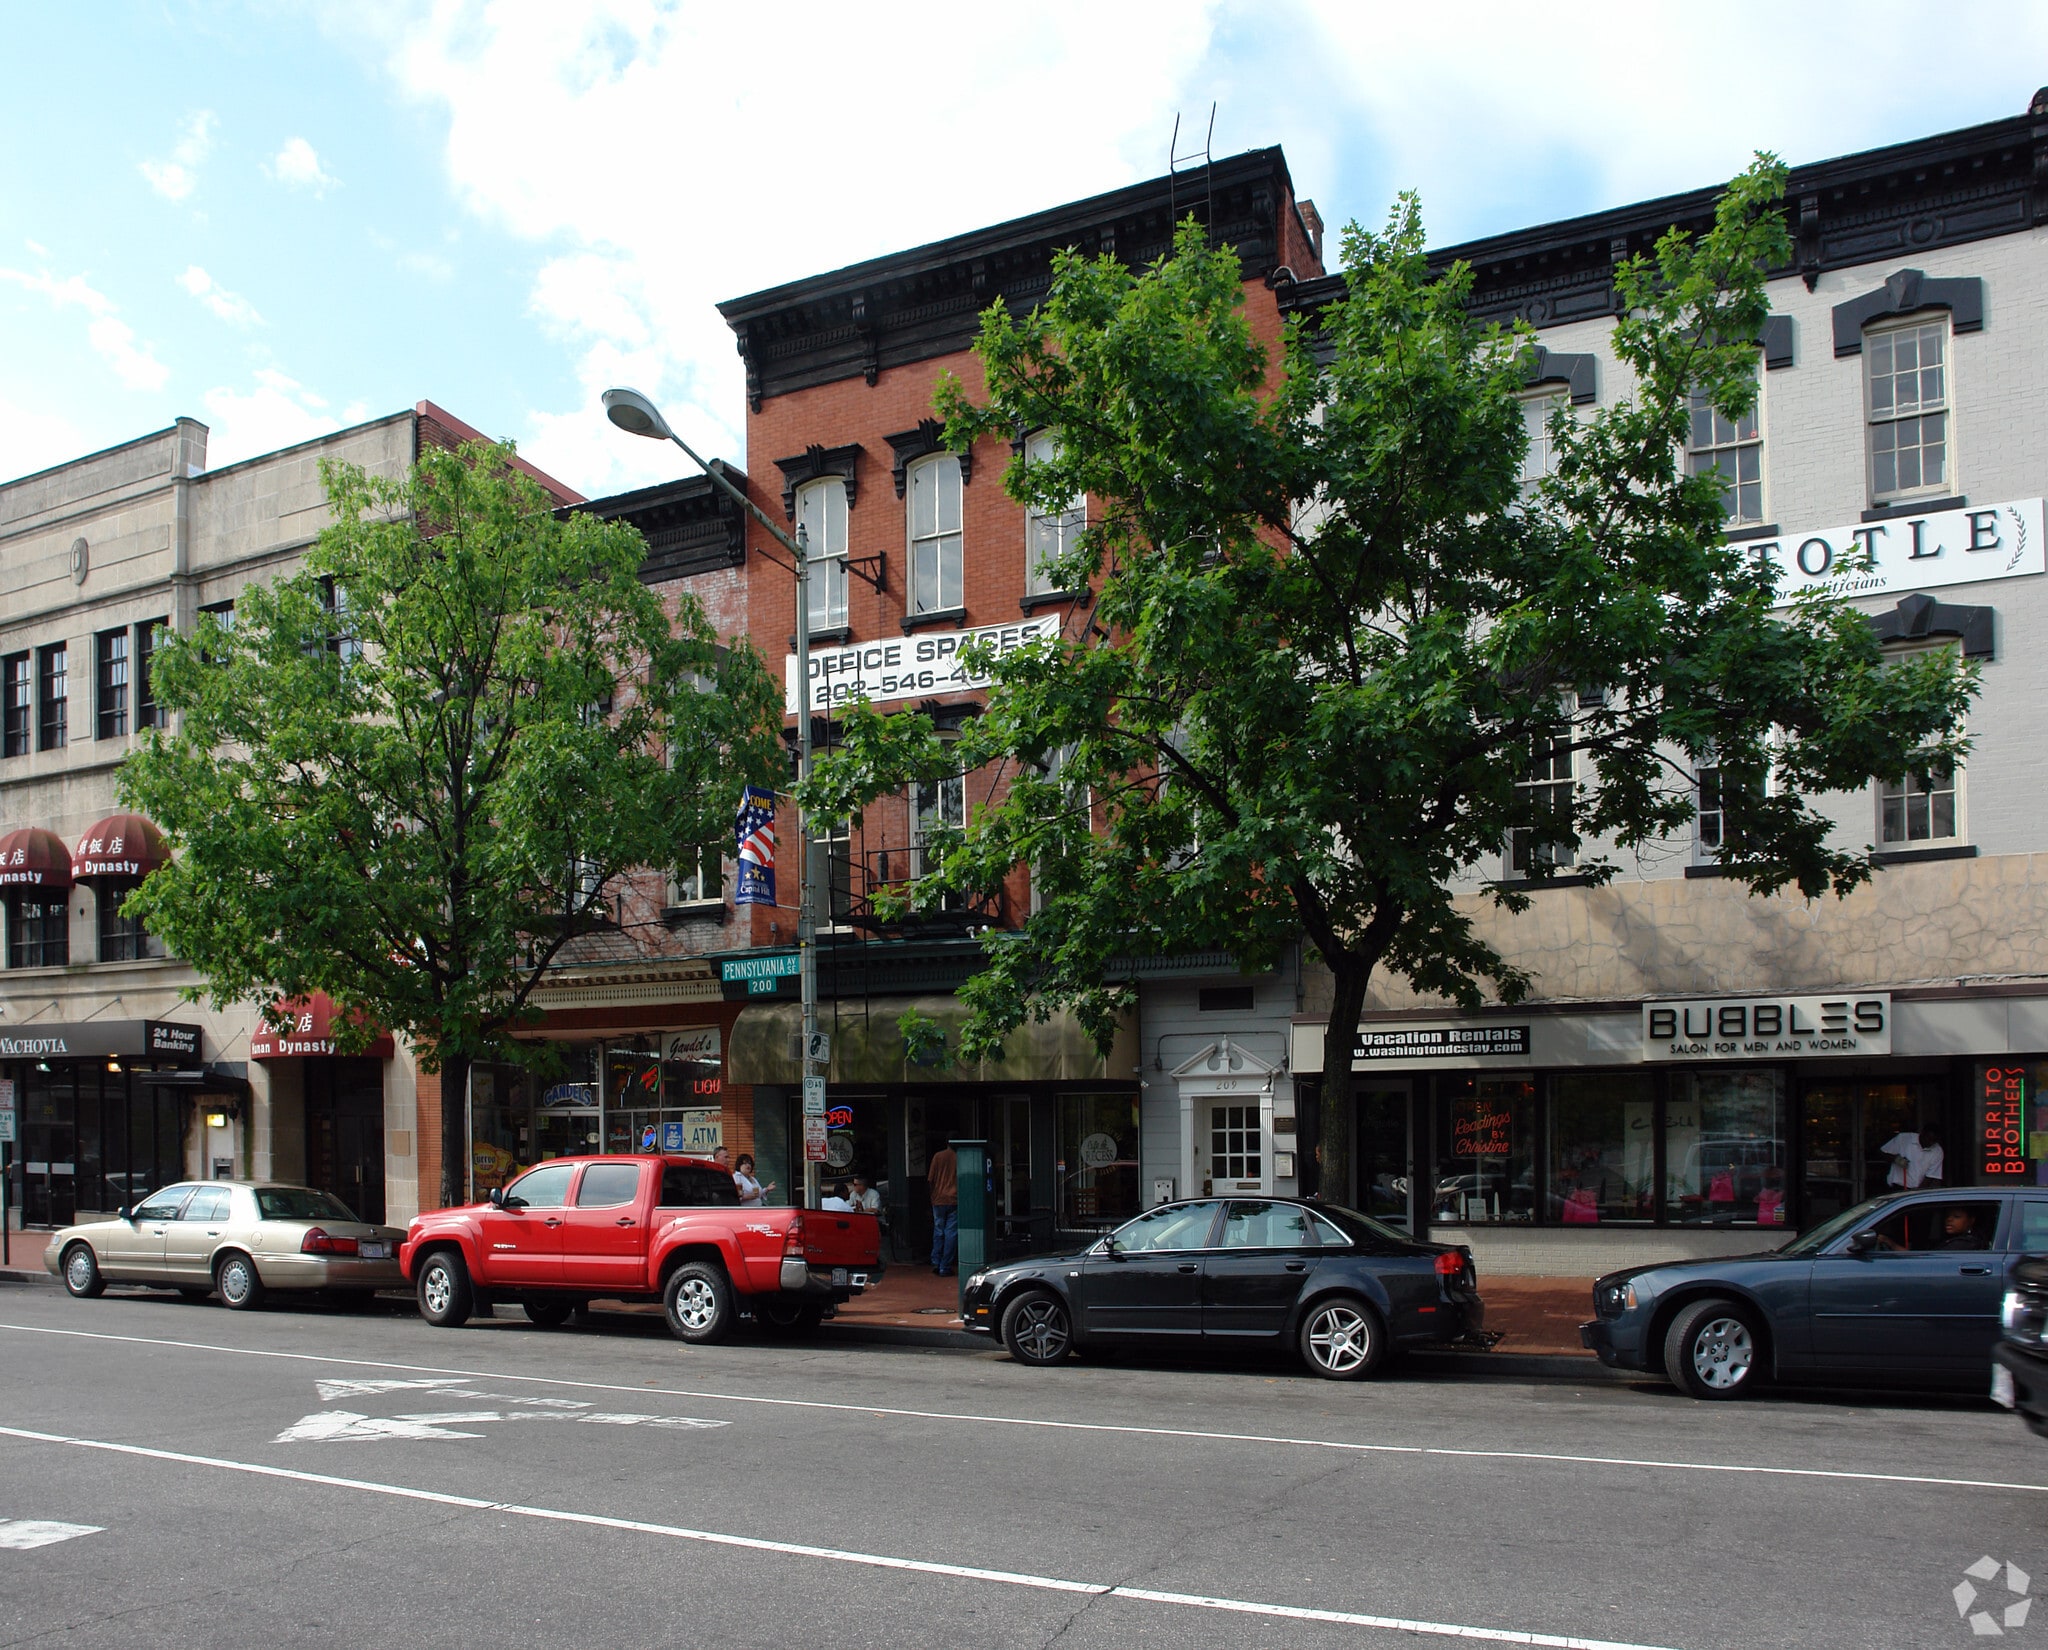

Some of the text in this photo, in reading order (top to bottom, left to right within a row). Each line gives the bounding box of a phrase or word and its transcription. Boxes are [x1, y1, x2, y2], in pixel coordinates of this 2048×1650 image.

[85, 859, 139, 875] Dynasty
[724, 957, 797, 980] PENNSYLVANIA AV
[786, 966, 797, 976] SE
[752, 980, 772, 993] 200
[1649, 1001, 1883, 1040] BUBBLES
[153, 1027, 195, 1041] 24 Hour
[1361, 1028, 1522, 1047] Vacation Rentals
[153, 1038, 195, 1053] Banking
[279, 1039, 335, 1055] Dynasty
[669, 1034, 712, 1059] Gandel's
[1670, 1039, 1857, 1054] SALON FOR MEN AND WOMEN
[1216, 1080, 1237, 1091] 209
[543, 1083, 593, 1107] GANDELS
[822, 1110, 852, 1125] OPEN
[1454, 1111, 1511, 1136] Readings
[1985, 1067, 2002, 1173] BURRITO
[2004, 1067, 2025, 1173] BROTHERS
[692, 1127, 718, 1144] ATM
[1491, 1130, 1506, 1139] BY
[1456, 1138, 1509, 1155] Christine
[986, 1158, 992, 1173] P
